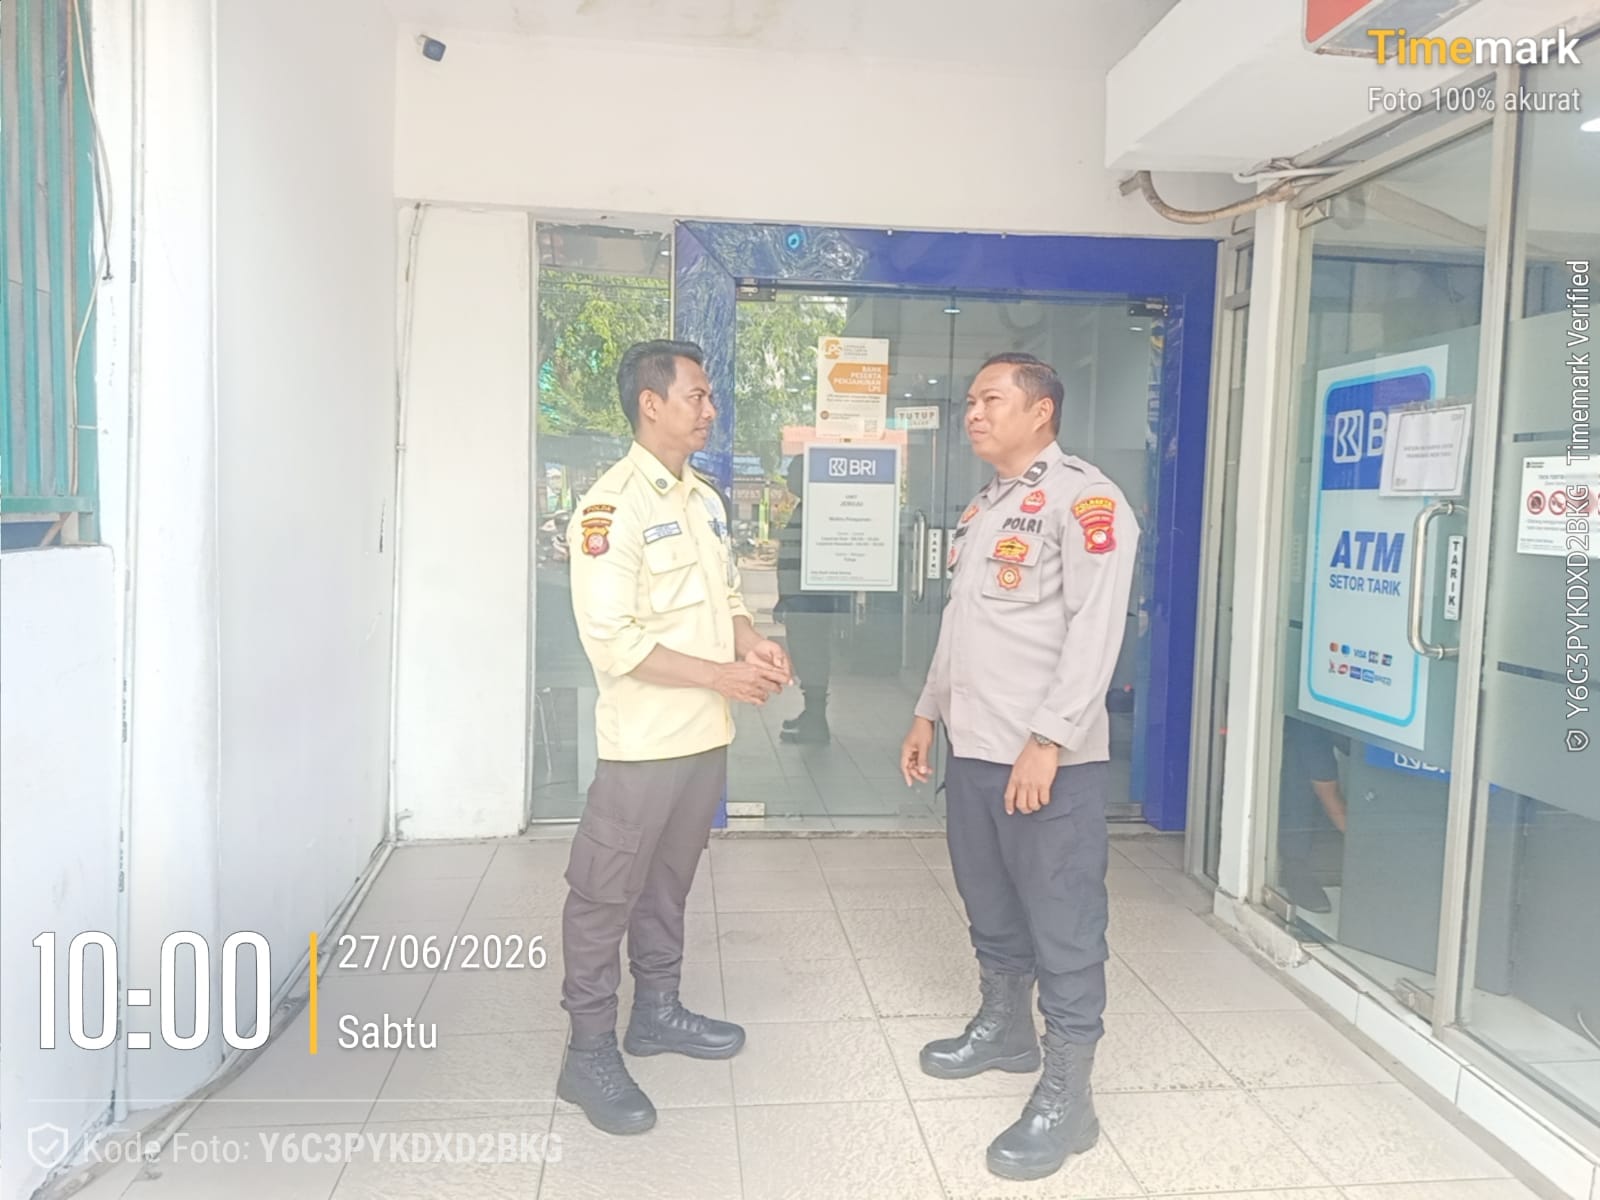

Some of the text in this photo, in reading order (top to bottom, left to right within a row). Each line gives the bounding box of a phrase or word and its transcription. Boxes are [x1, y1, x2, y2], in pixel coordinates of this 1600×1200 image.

[899, 411, 935, 421] TUTUP
[849, 459, 876, 476] BRI
[1002, 517, 1043, 534] POLRI
[1329, 530, 1405, 573] ATM
[1448, 541, 1460, 606] TARIK
[1329, 574, 1401, 597] SETOR TARIK
